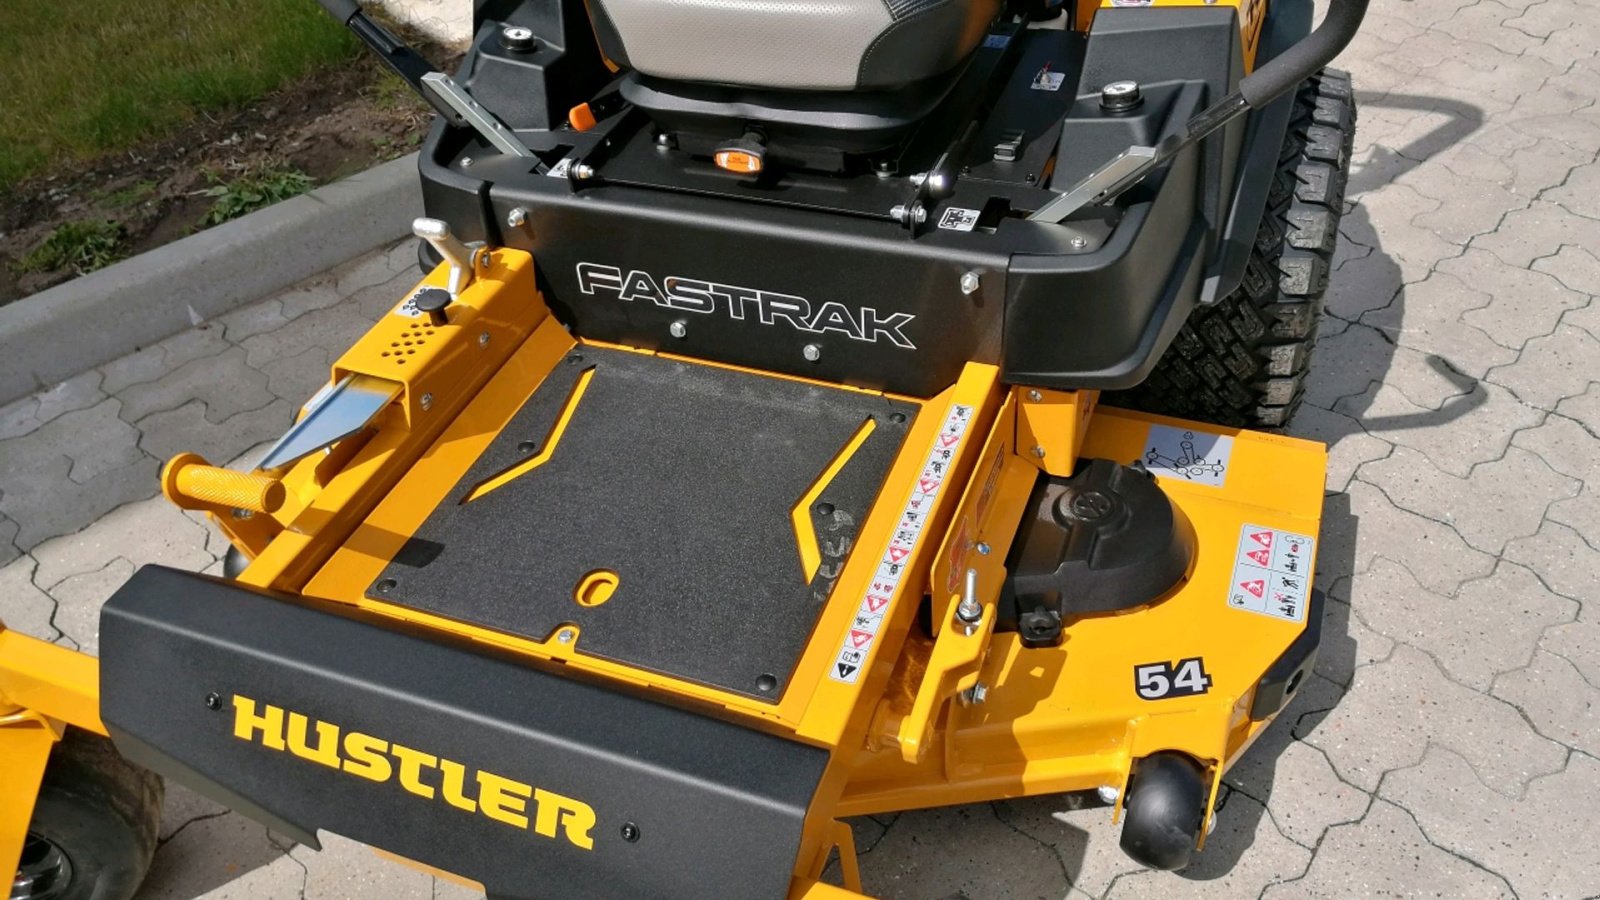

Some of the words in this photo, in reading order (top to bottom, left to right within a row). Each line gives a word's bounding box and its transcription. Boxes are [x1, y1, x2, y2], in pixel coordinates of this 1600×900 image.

[576, 262, 917, 350] FASTRAK
[1137, 659, 1210, 699] 54
[233, 694, 596, 851] HUSTLER
